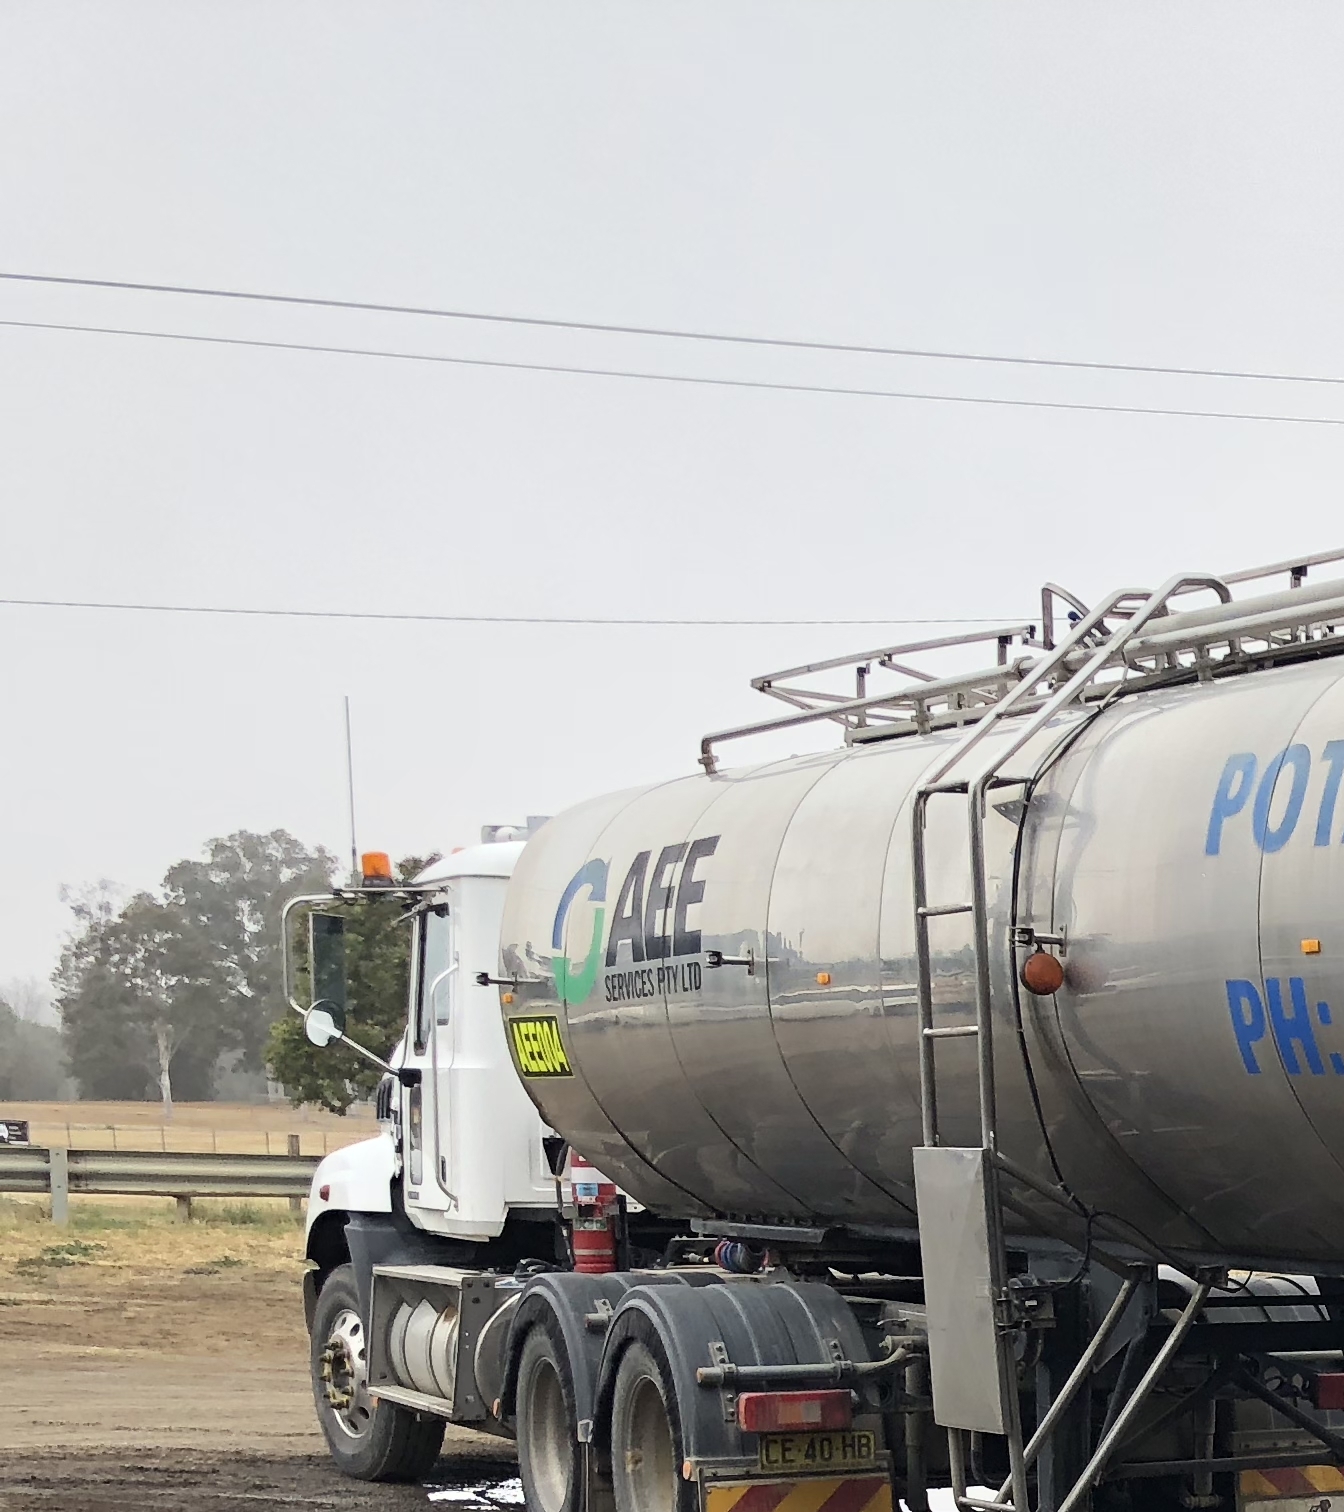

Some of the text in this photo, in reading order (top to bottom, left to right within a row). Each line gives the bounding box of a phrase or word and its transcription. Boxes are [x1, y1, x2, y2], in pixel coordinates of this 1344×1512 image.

[604, 834, 722, 968] AEE
[604, 961, 702, 1002] SERVICES PTY LTD
[512, 1020, 570, 1073] AEE004
